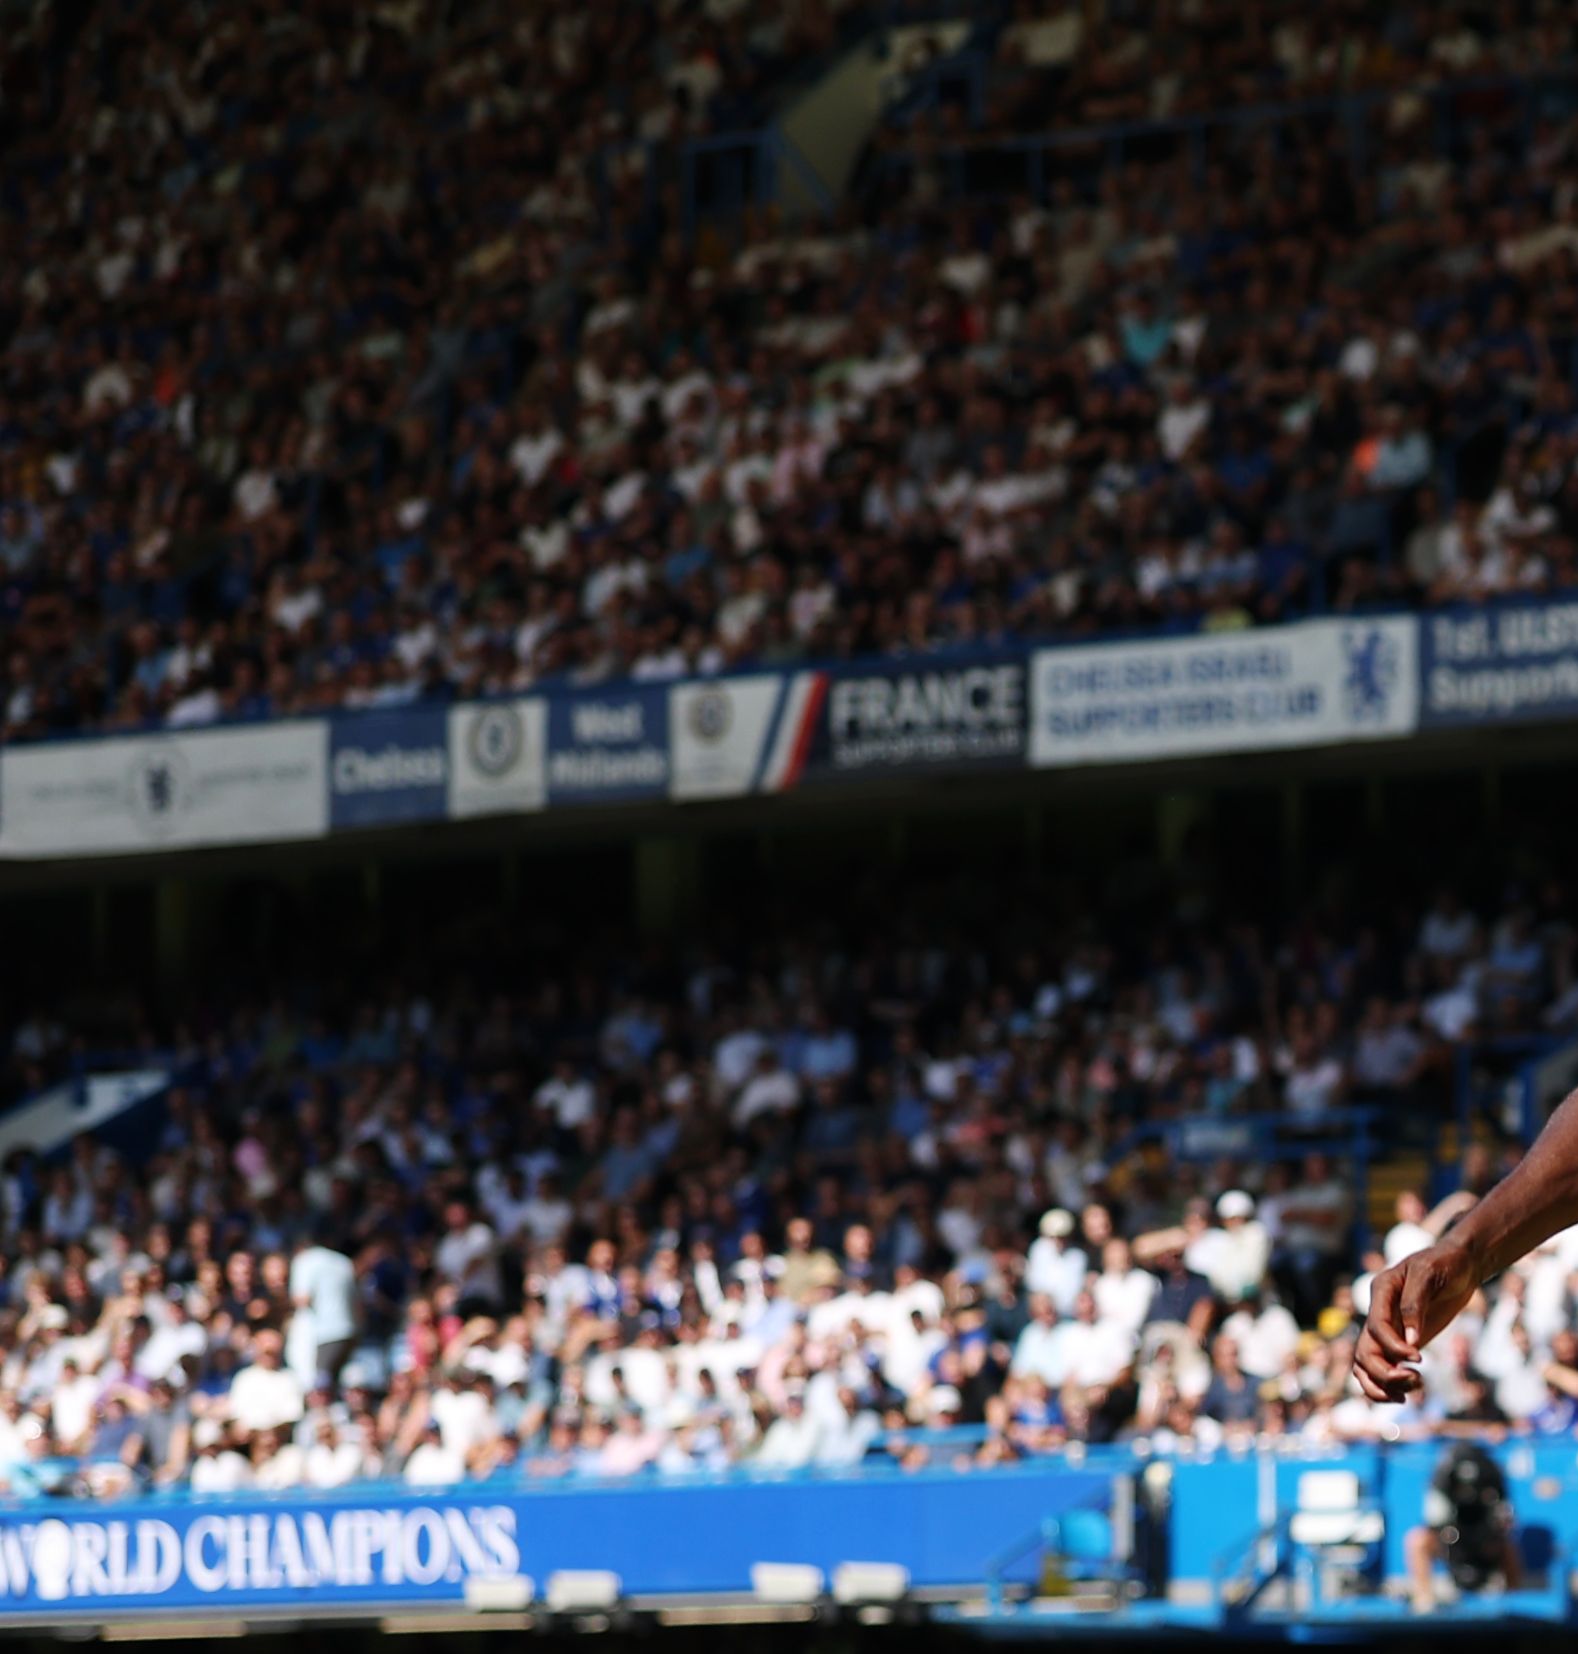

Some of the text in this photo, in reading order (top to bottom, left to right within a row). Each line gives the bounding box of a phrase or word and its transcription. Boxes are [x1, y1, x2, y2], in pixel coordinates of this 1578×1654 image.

[1050, 648, 1290, 696] CHELSEA ISRAEL
[829, 665, 1021, 736] FRANCE
[1050, 682, 1322, 736] SUPPORTERS CLUB
[334, 744, 444, 794] Chelsea
[184, 1504, 521, 1593] CHAMPIONS
